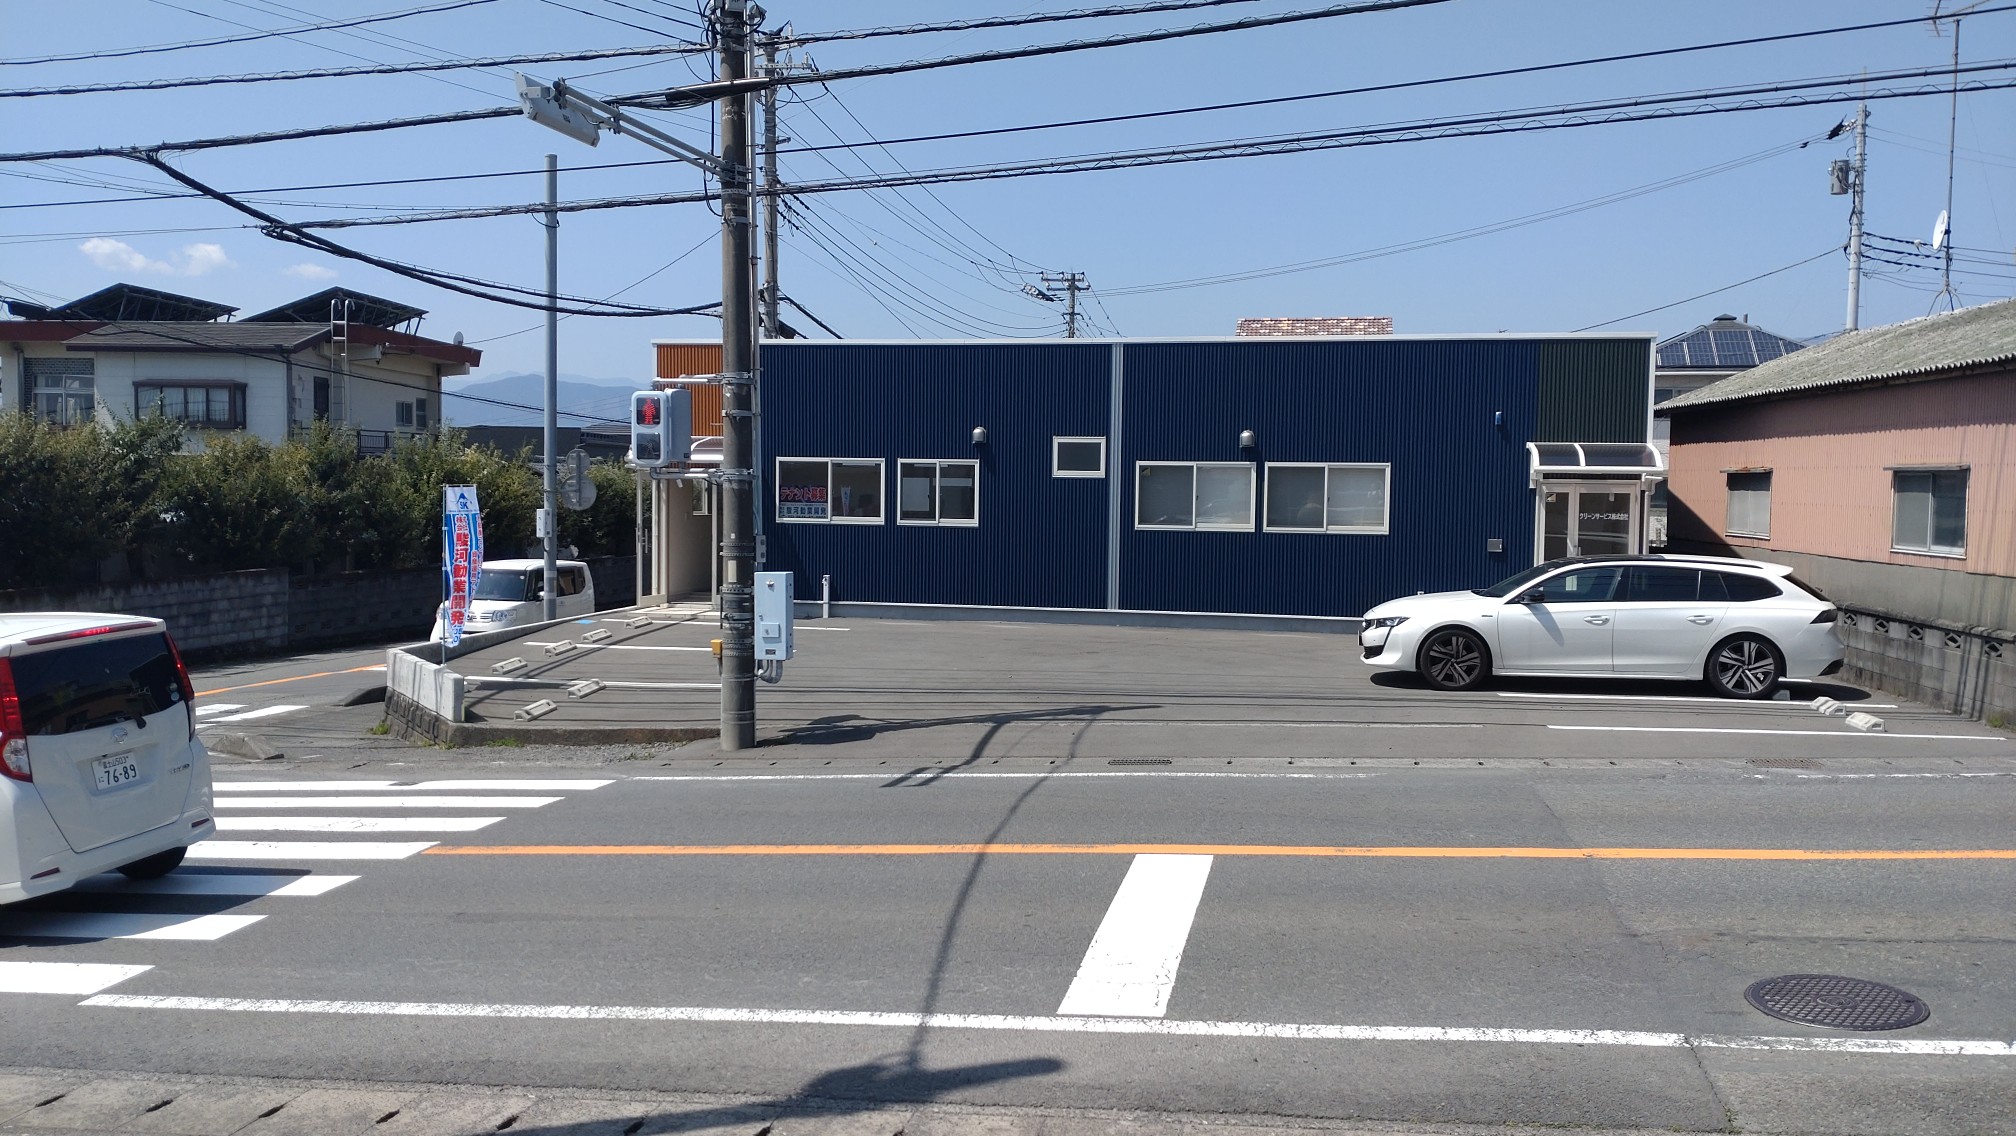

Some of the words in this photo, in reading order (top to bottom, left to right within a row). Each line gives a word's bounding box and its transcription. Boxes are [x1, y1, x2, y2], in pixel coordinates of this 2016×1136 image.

[781, 487, 826, 501] テナント募集
[460, 501, 469, 510] SK
[450, 532, 469, 624] 駿河勧業開発
[104, 764, 137, 785] 76-89
